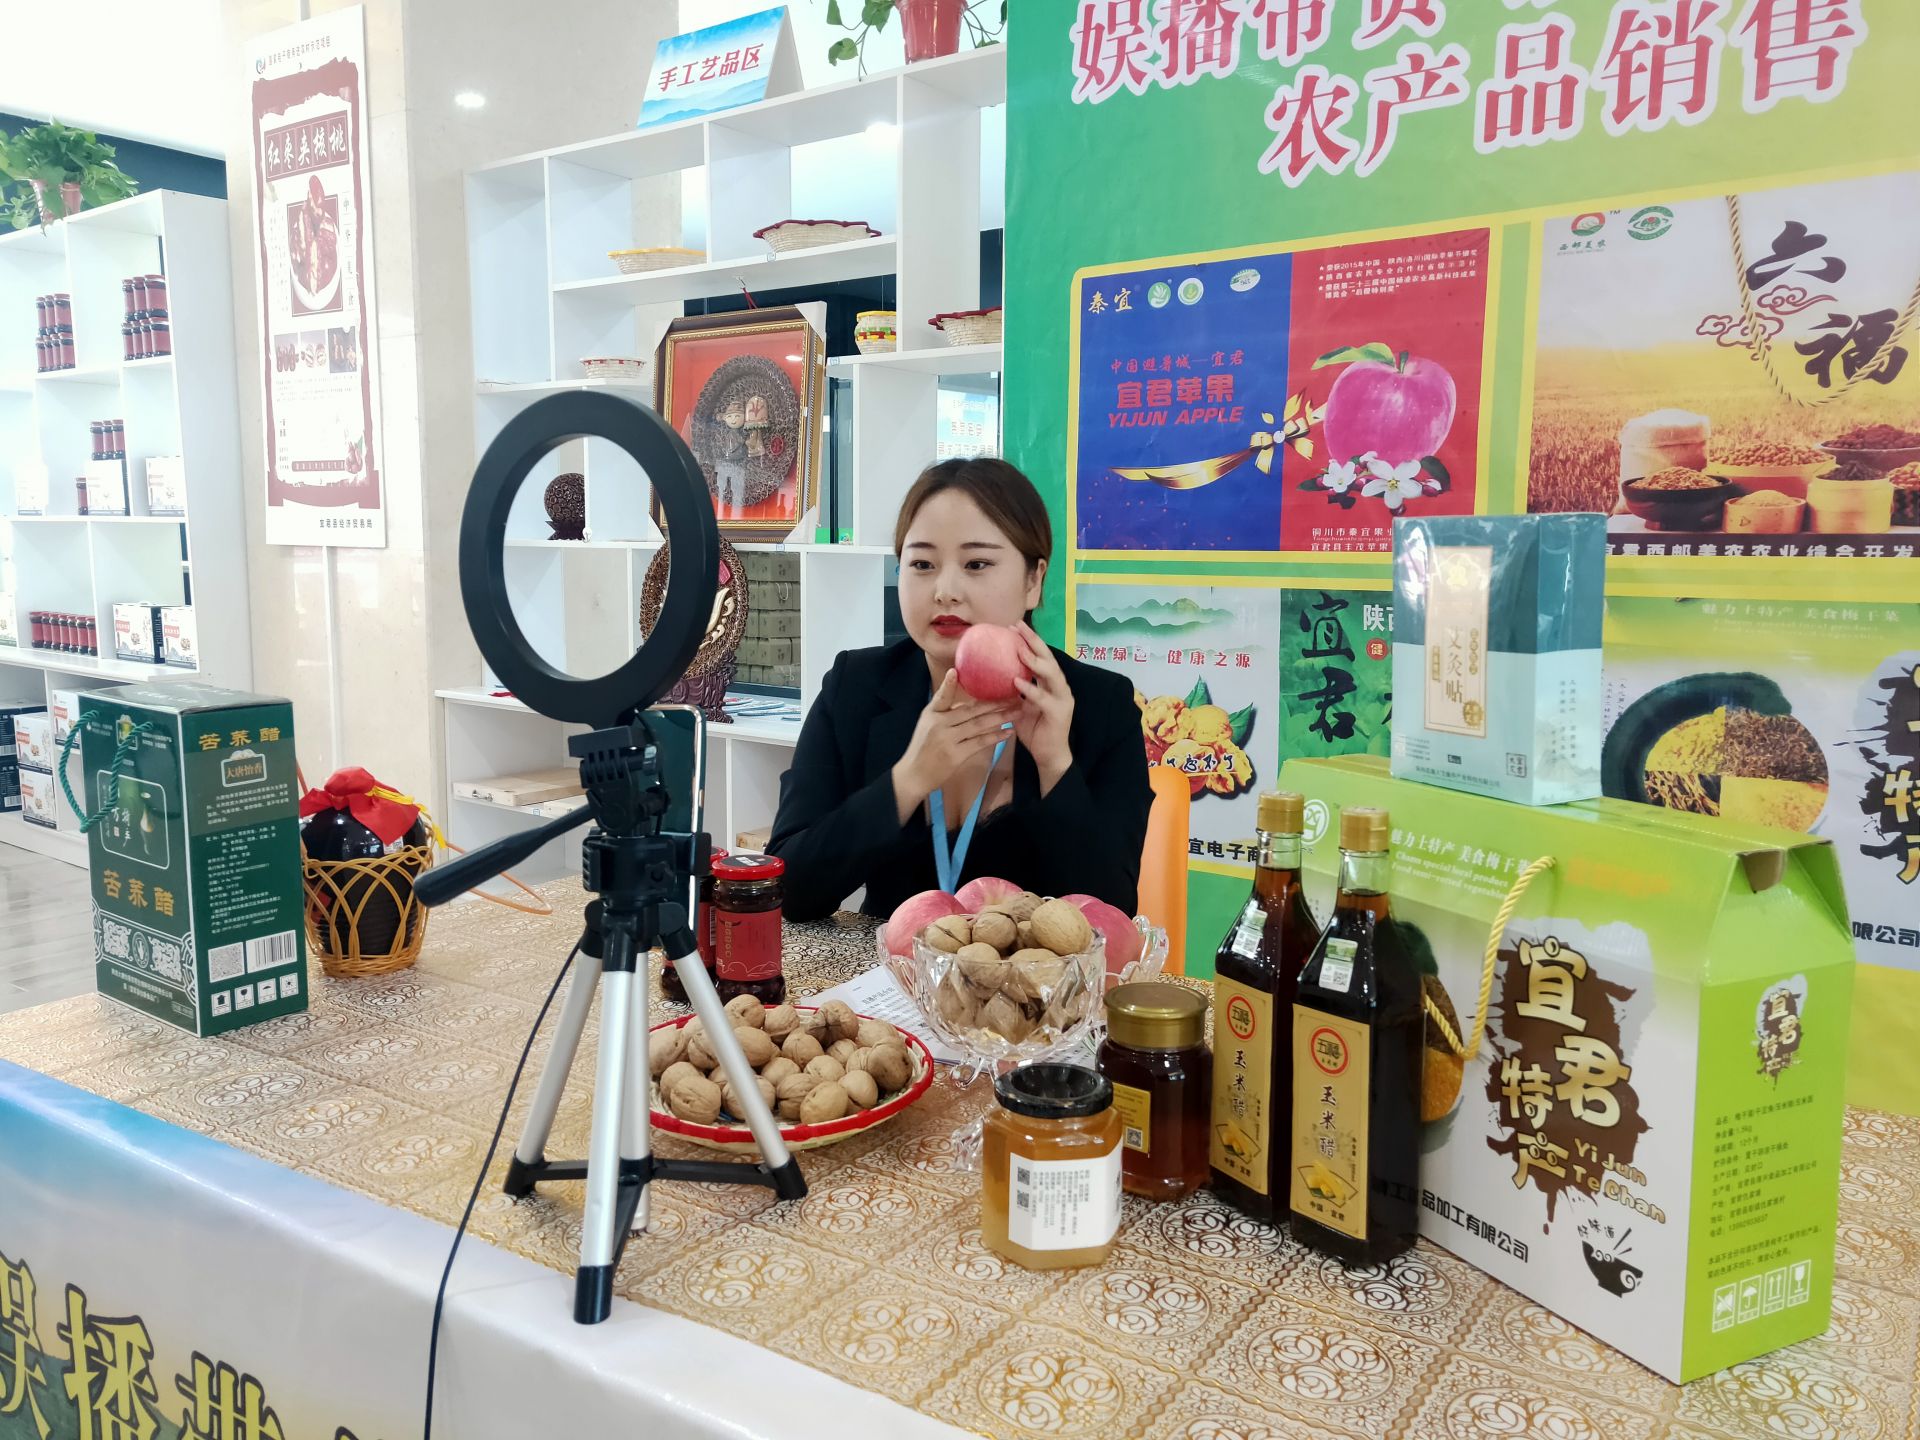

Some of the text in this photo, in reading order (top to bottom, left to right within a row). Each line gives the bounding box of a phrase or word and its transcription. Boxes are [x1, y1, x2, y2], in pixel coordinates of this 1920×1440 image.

[658, 43, 764, 92] 手工艺品区
[1266, 0, 1855, 178] 农产品销售
[266, 124, 347, 172] 红枣夹核桃
[1107, 406, 1245, 428] YIJUN APPLE
[1116, 374, 1234, 409] 宜君苹果
[1076, 646, 1252, 668] 天然绿色 健康之源
[1298, 590, 1358, 743] 宜君
[1149, 754, 1235, 772] 忘不了
[1515, 935, 1634, 1129] 宜君
[1232, 1048, 1248, 1120] 玉米醋
[1319, 1085, 1337, 1161] 玉米醋
[1499, 1056, 1570, 1191] 特产
[1571, 1162, 1602, 1193] Te
[1603, 1176, 1668, 1226] Chan
[1573, 1137, 1649, 1188] Yi Jun
[0, 1250, 386, 1440] 娱播带
